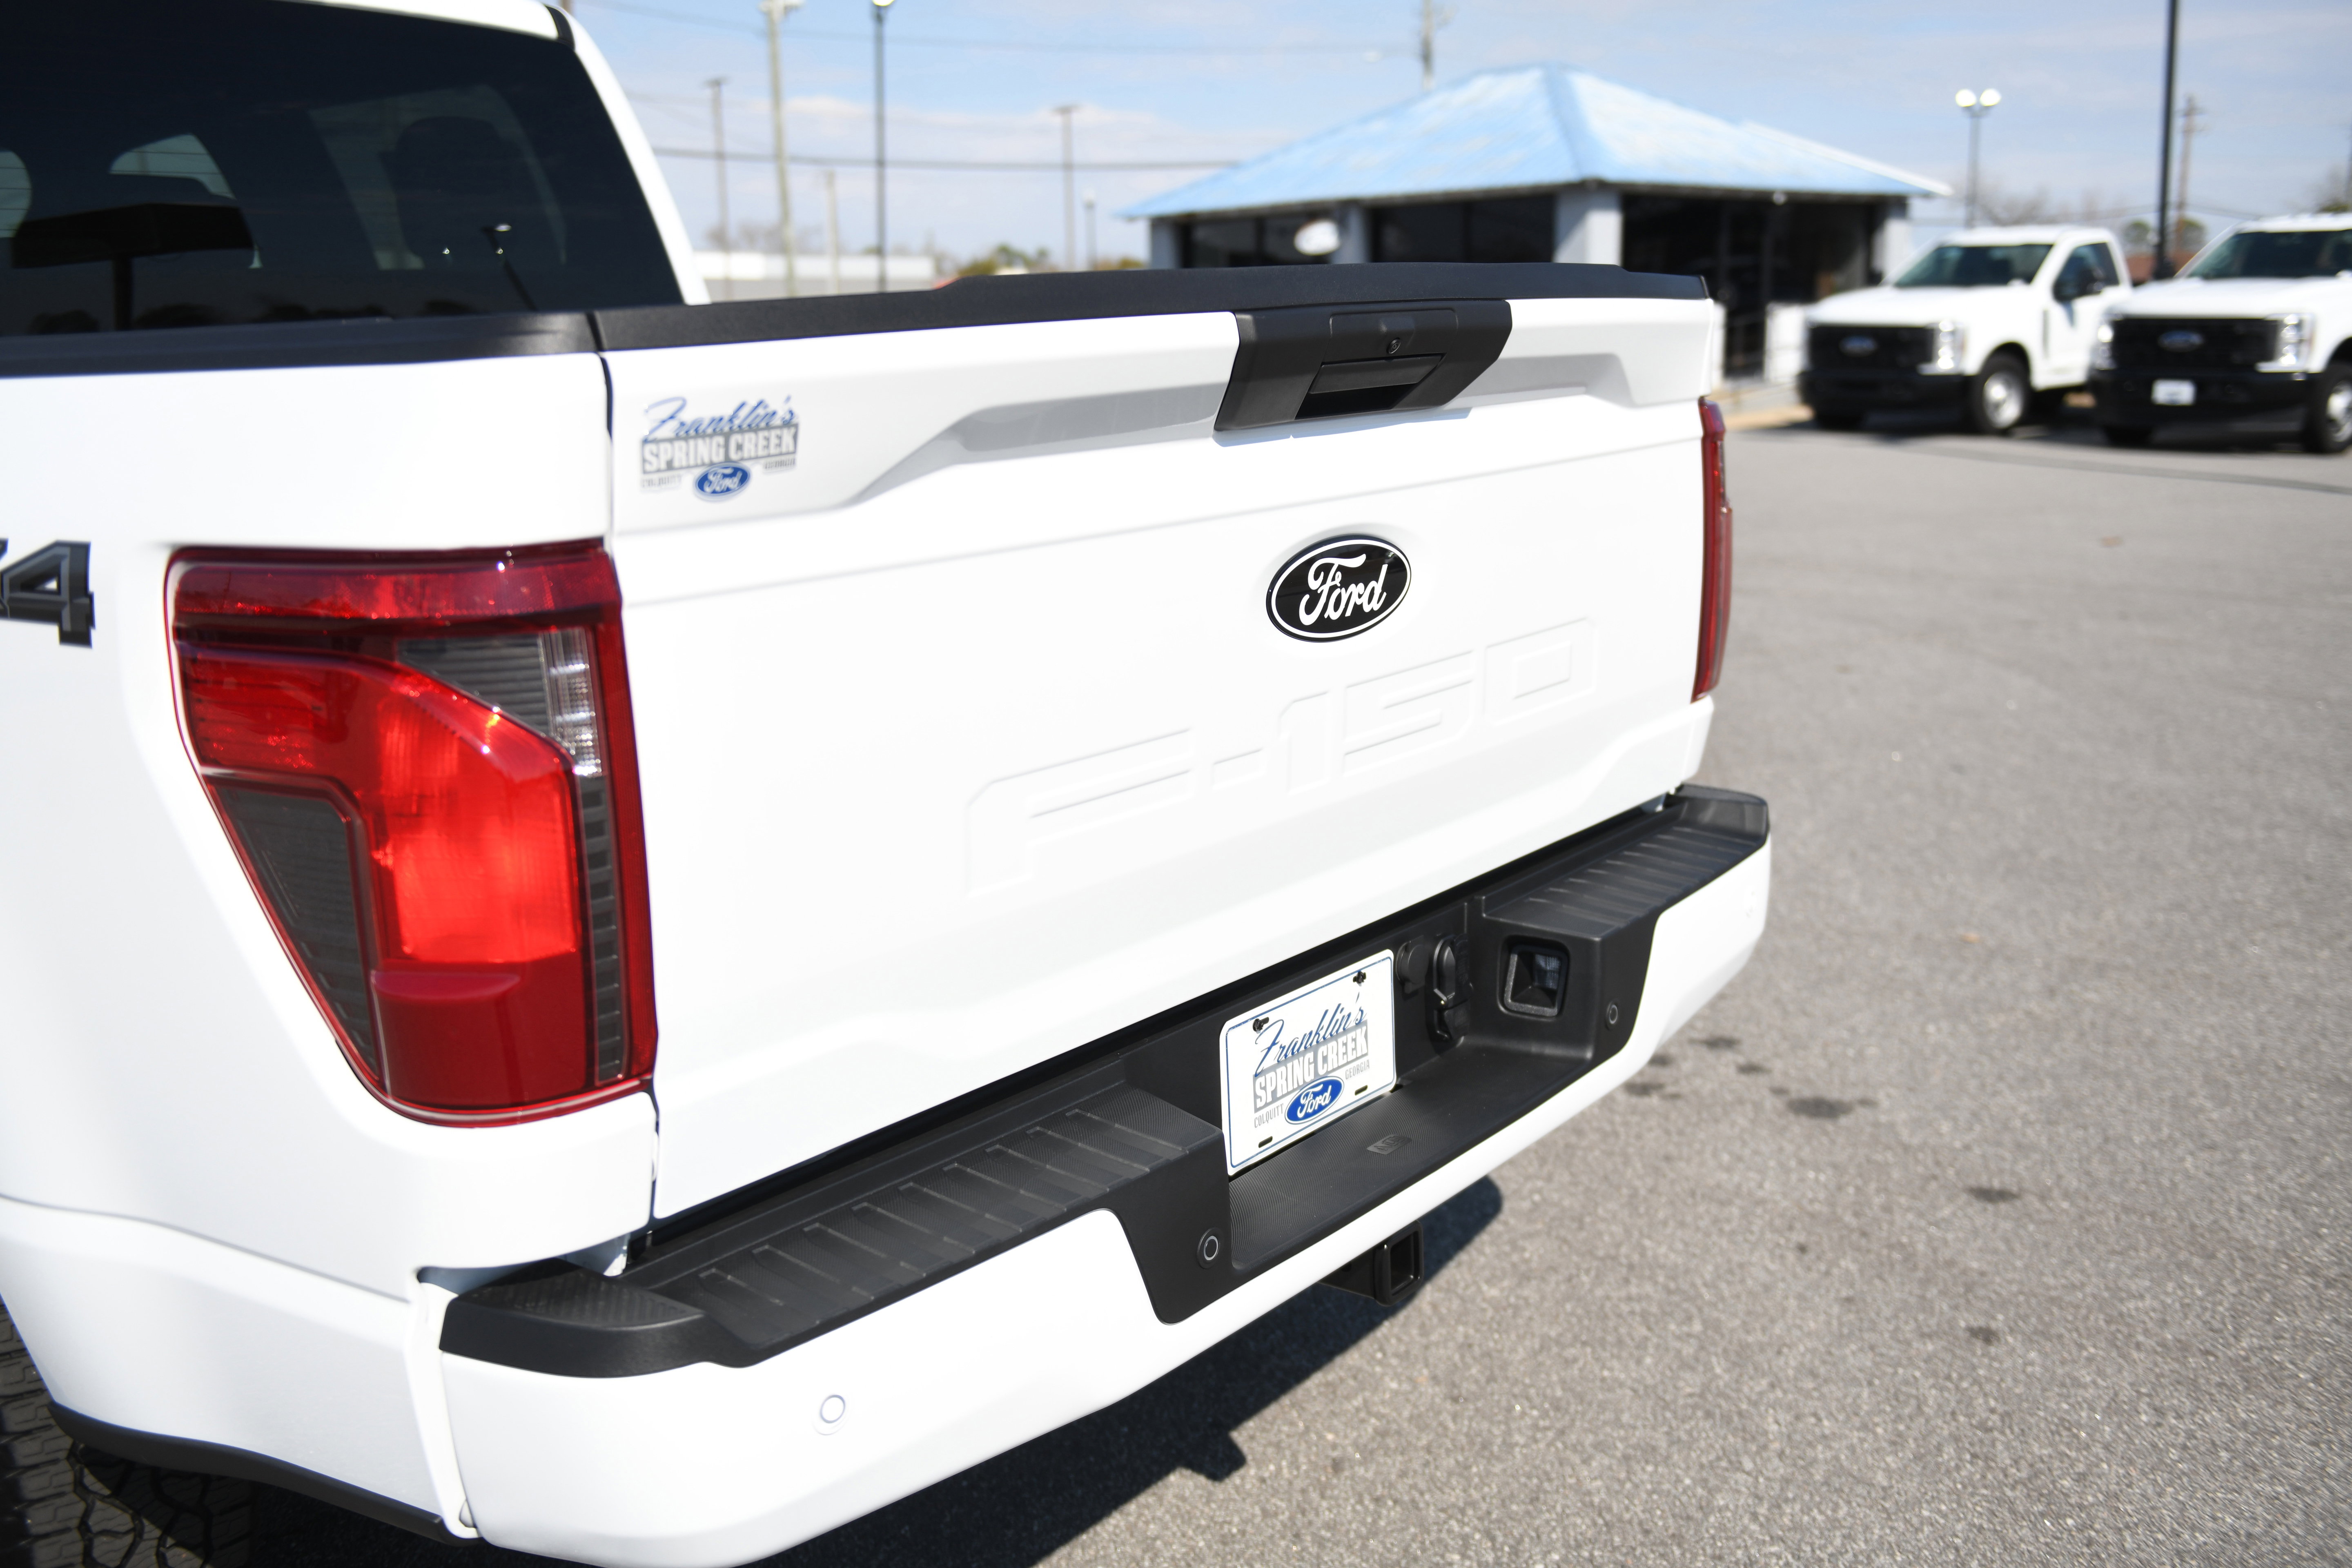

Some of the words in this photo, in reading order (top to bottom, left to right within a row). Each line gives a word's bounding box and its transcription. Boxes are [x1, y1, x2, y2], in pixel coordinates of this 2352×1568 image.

[644, 396, 794, 443] Franklin's
[643, 434, 725, 473] SPRING
[728, 426, 796, 461] CREEK
[704, 467, 742, 493] Ford
[1299, 554, 1388, 626] Ford
[965, 616, 1599, 899] F-150
[1254, 991, 1367, 1077] Franklin's
[1254, 1051, 1315, 1108] SPRING
[1317, 1025, 1368, 1076] CREEK
[1345, 1059, 1370, 1080] GEORGIA
[1254, 1102, 1284, 1129] COLQUITT
[1297, 1083, 1332, 1118] Ford
